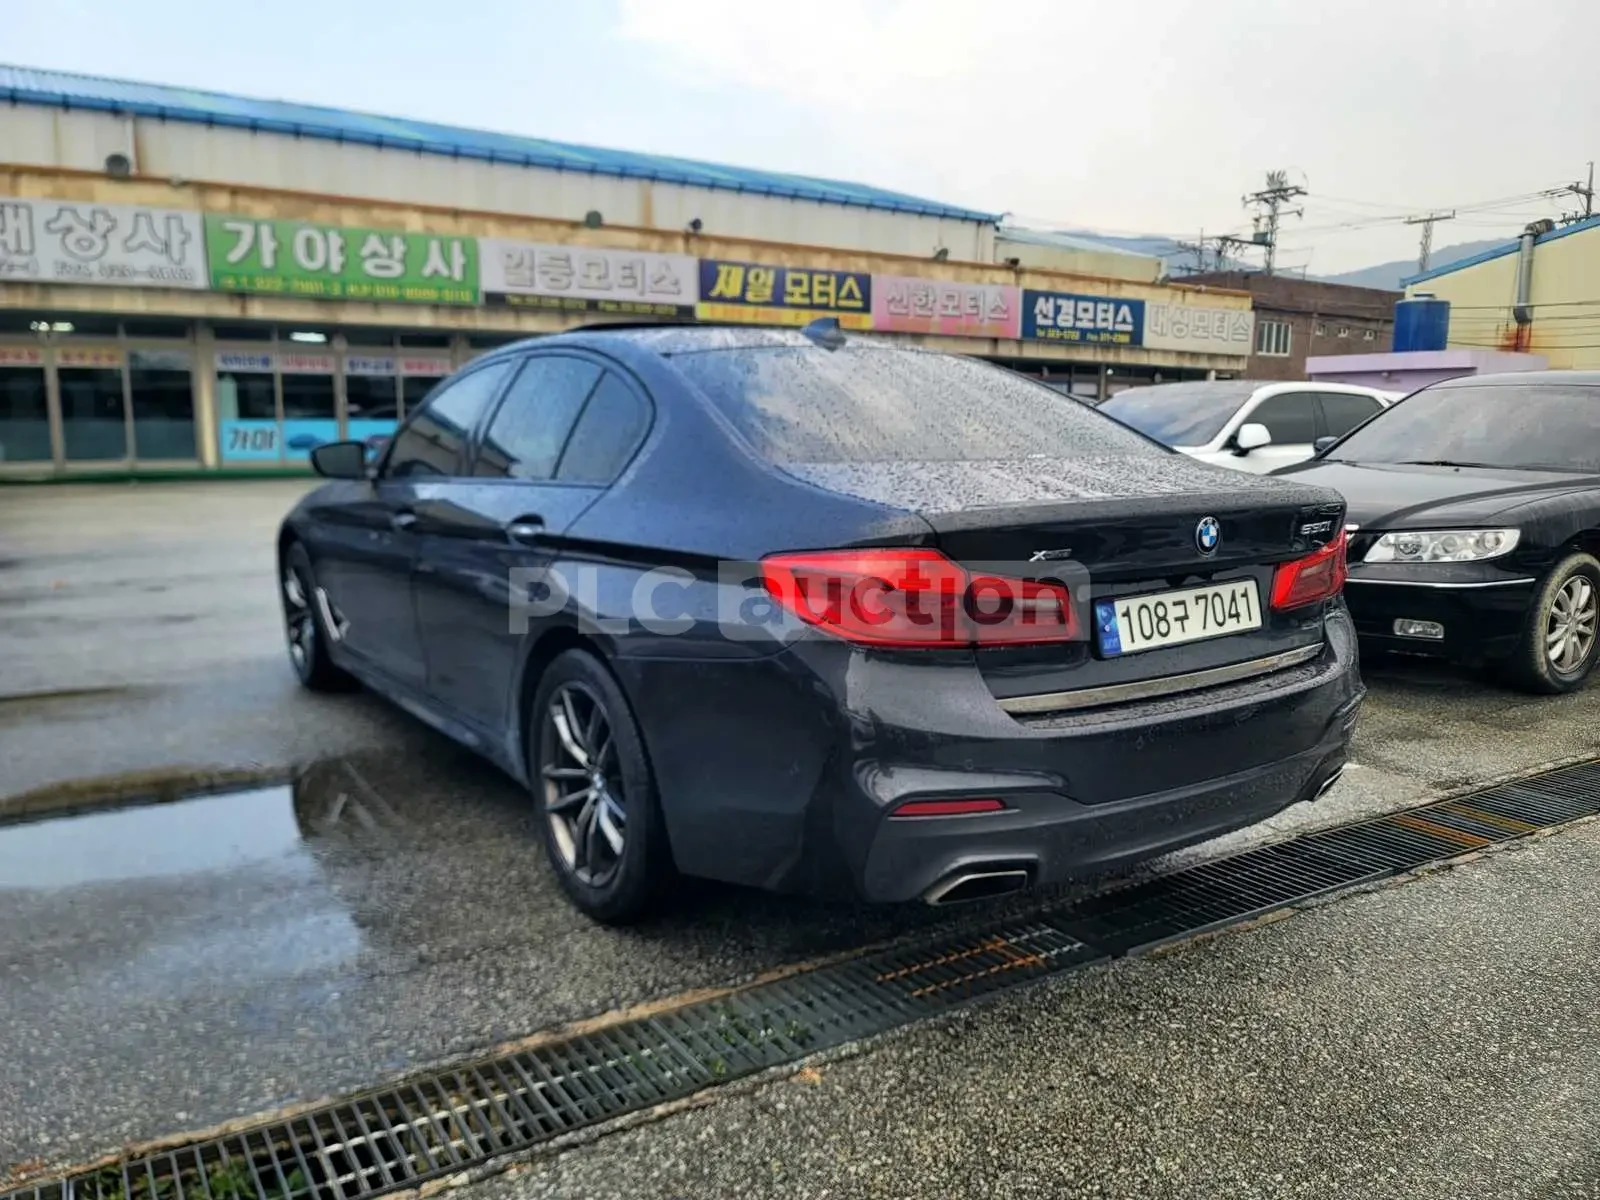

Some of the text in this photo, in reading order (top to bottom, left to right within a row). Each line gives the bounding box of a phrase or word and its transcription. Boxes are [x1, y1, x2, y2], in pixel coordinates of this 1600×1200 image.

[223, 222, 467, 282] 가야상사
[784, 271, 864, 308] 모터스
[1121, 586, 1253, 643] 108구 7041
